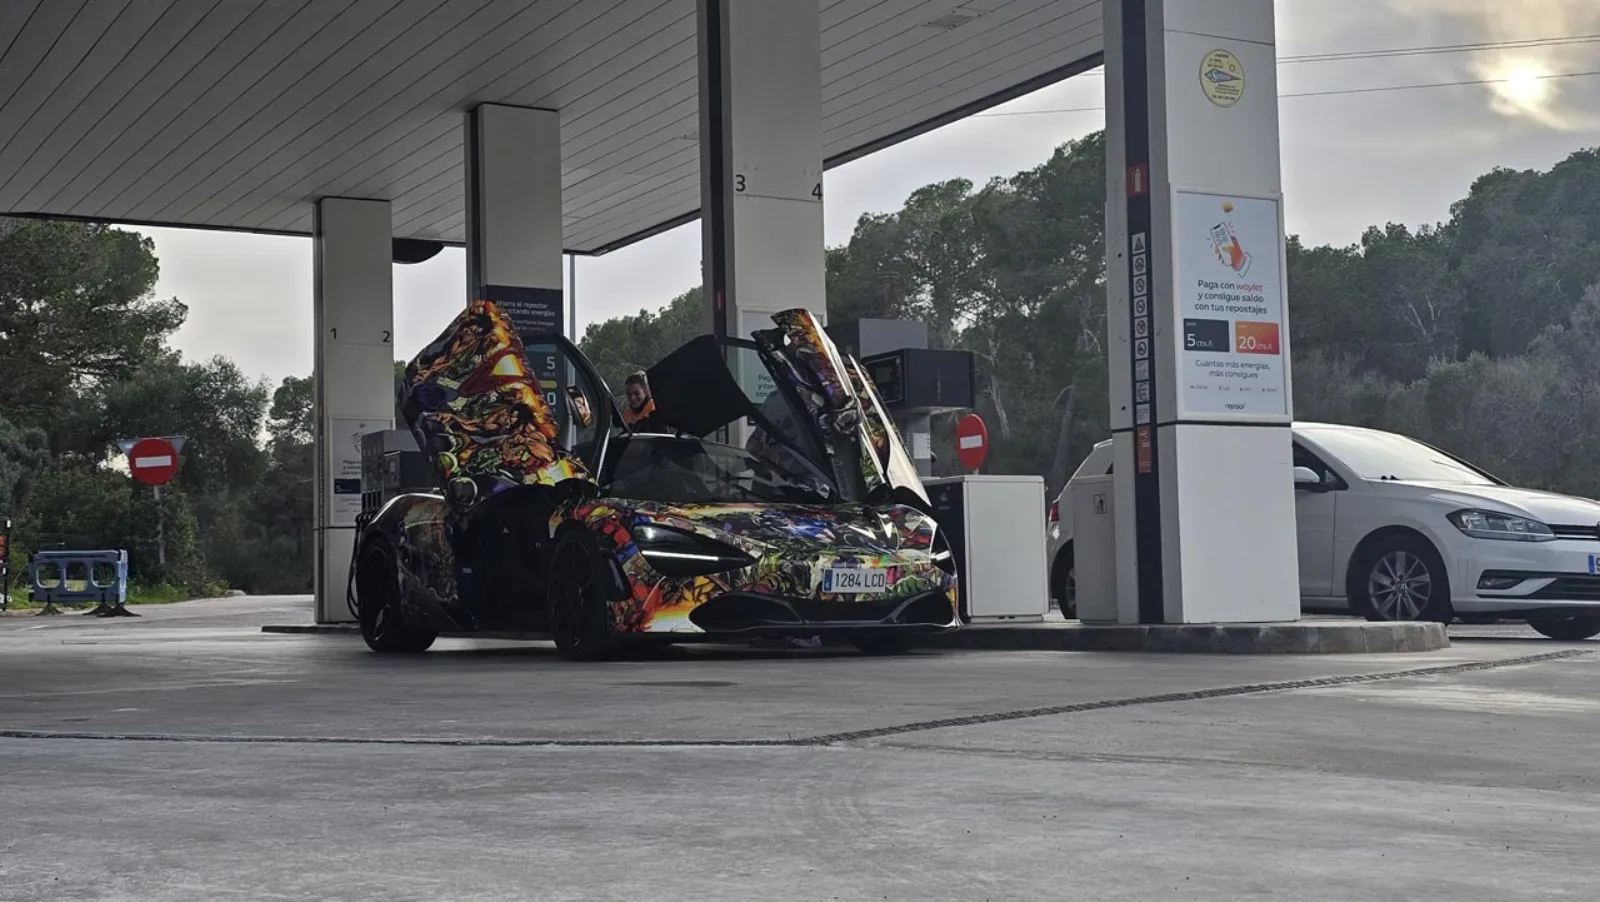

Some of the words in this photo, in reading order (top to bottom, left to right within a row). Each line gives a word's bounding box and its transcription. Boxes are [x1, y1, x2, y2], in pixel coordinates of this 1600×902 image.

[735, 174, 746, 192] 3
[811, 183, 823, 200] 4
[1197, 279, 1219, 290] Paga
[1219, 282, 1235, 290] con
[1197, 292, 1203, 301] y
[1204, 292, 1240, 302] consigue
[1242, 294, 1264, 303] saldo
[1194, 303, 1210, 311] con
[1211, 303, 1225, 312] tus
[1225, 304, 1267, 315] repostajes
[330, 327, 337, 340] 1
[382, 330, 391, 343] 2
[1186, 333, 1196, 347] 5
[1239, 336, 1256, 350] 20
[546, 356, 556, 370] 5
[835, 573, 861, 588] 1284
[864, 573, 885, 588] LCD
